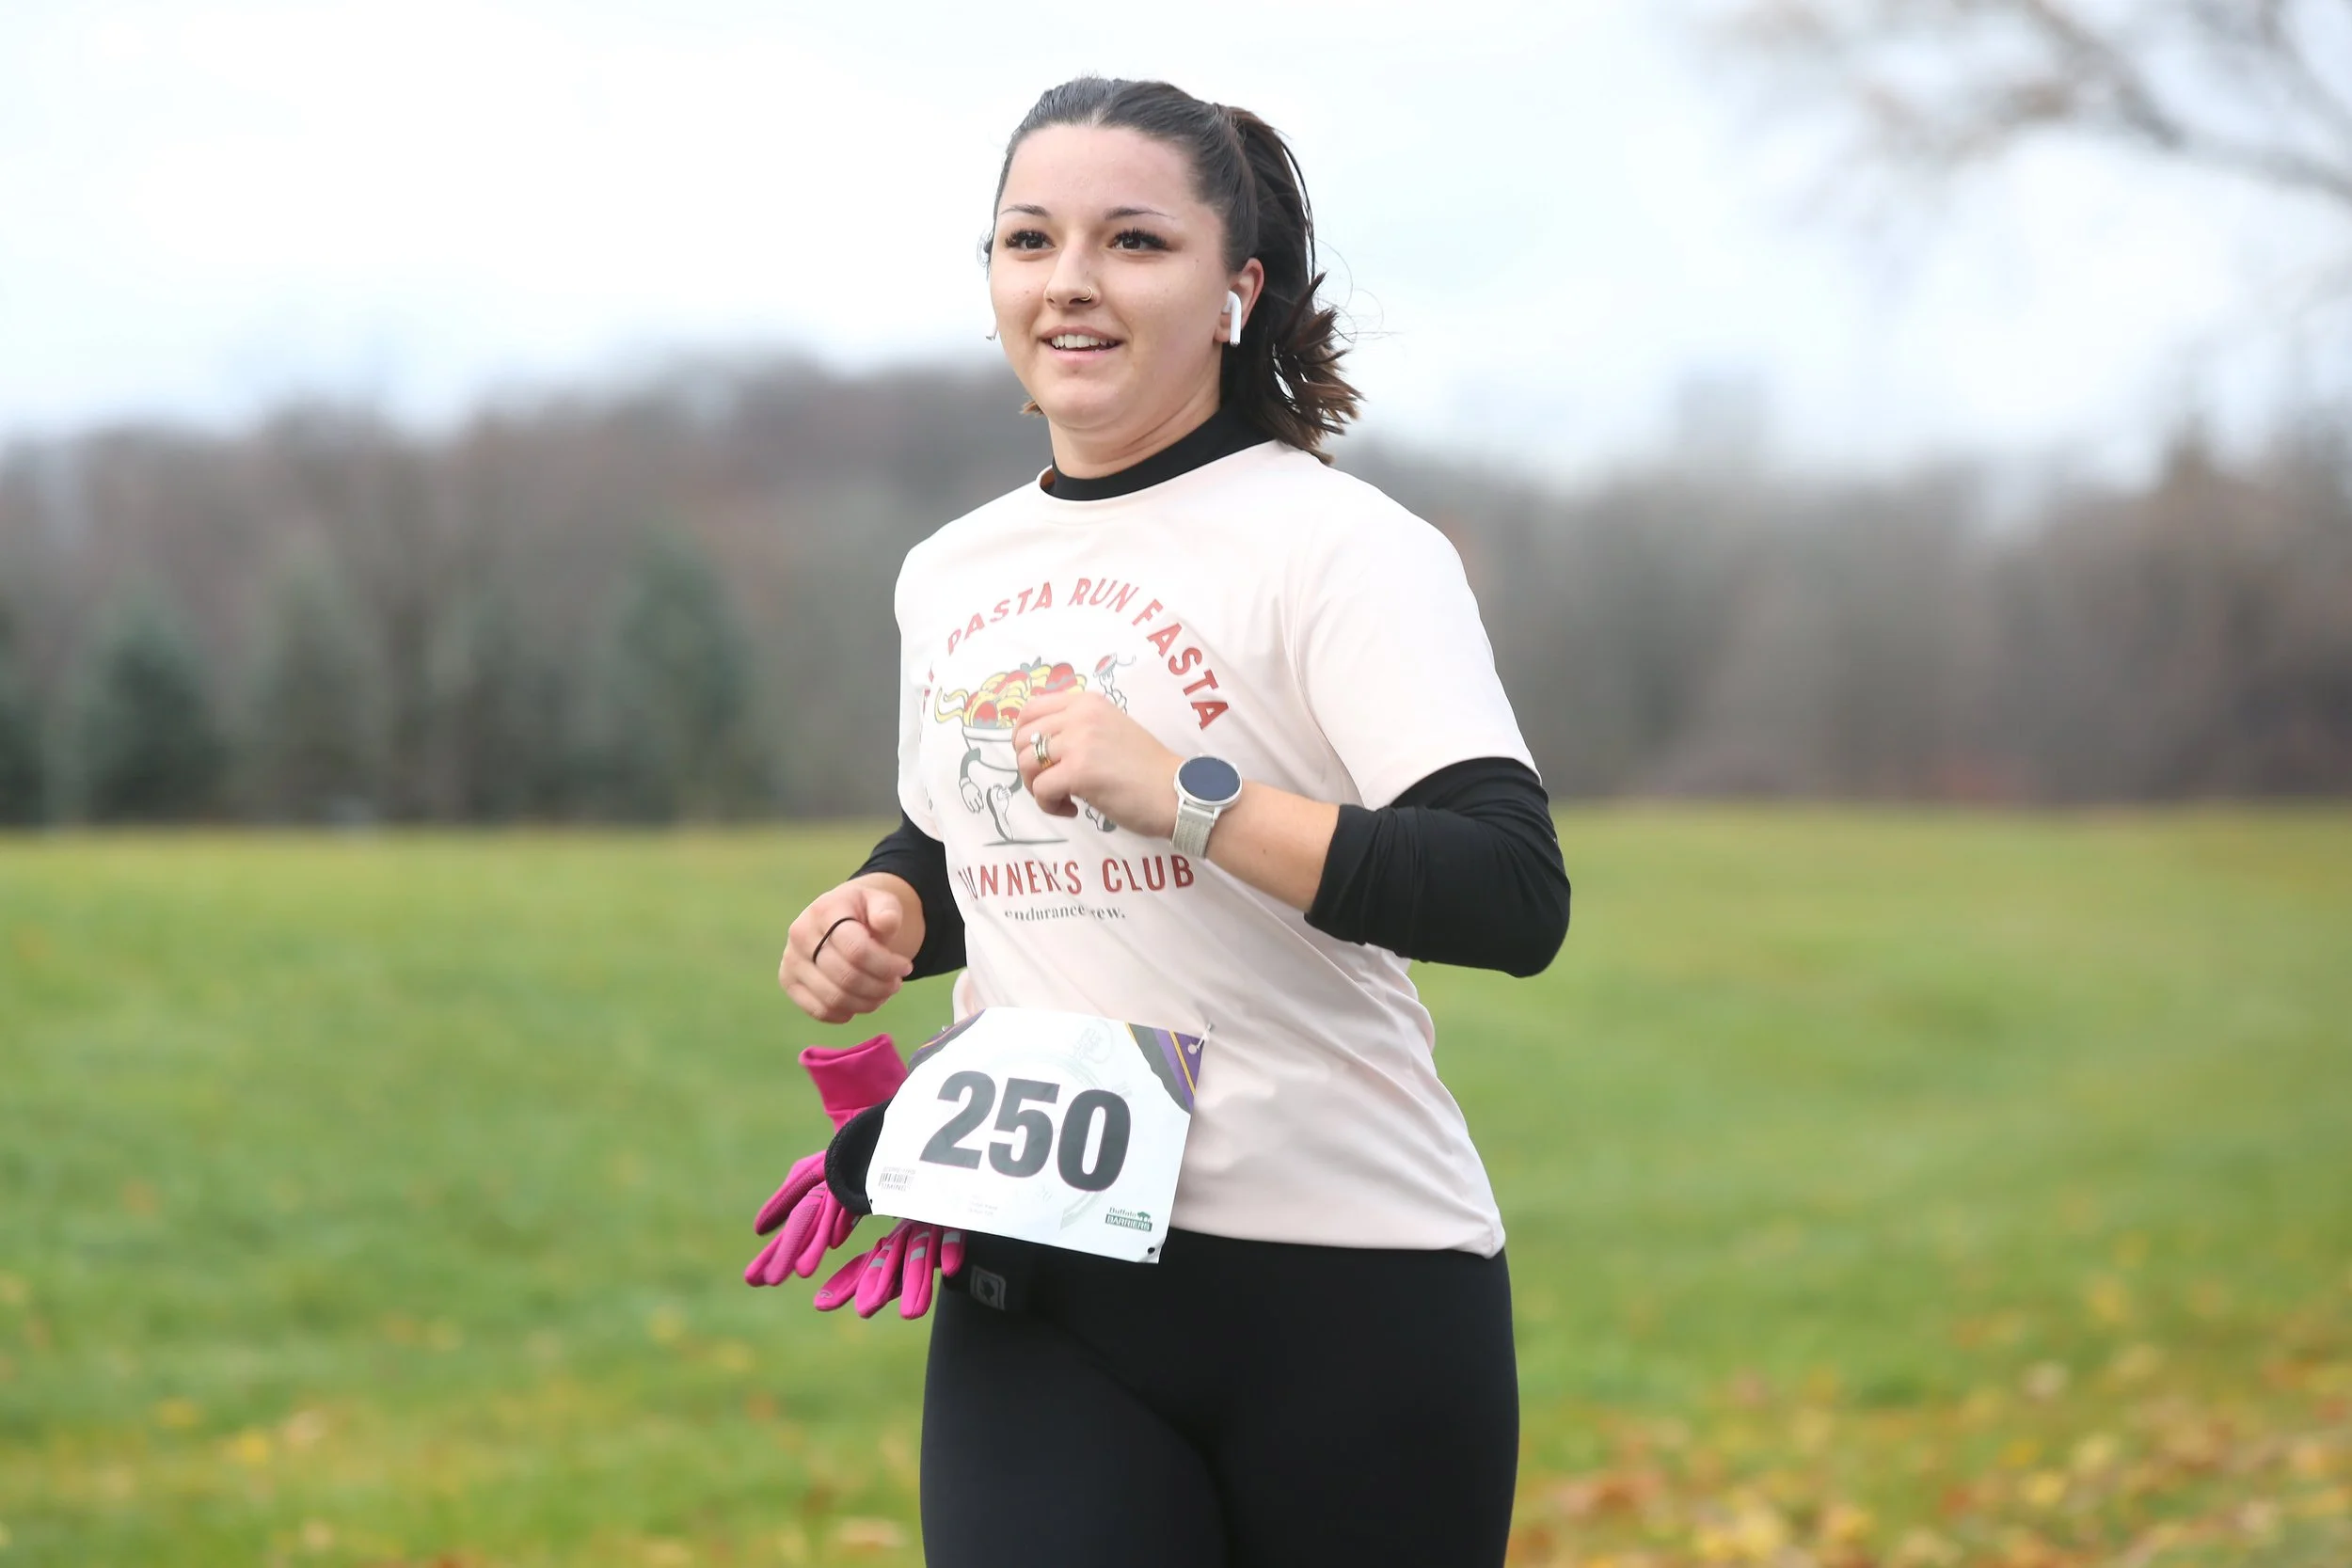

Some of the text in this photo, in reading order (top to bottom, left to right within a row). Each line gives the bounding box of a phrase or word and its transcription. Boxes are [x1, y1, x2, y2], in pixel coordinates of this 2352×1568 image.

[946, 578, 1230, 731] PASTA RUN FASTA
[1102, 853, 1194, 893] CLUB
[919, 1070, 1131, 1192] 250
[1107, 1215, 1151, 1231] BARRIERS
[1109, 1207, 1136, 1218] Buffalo
